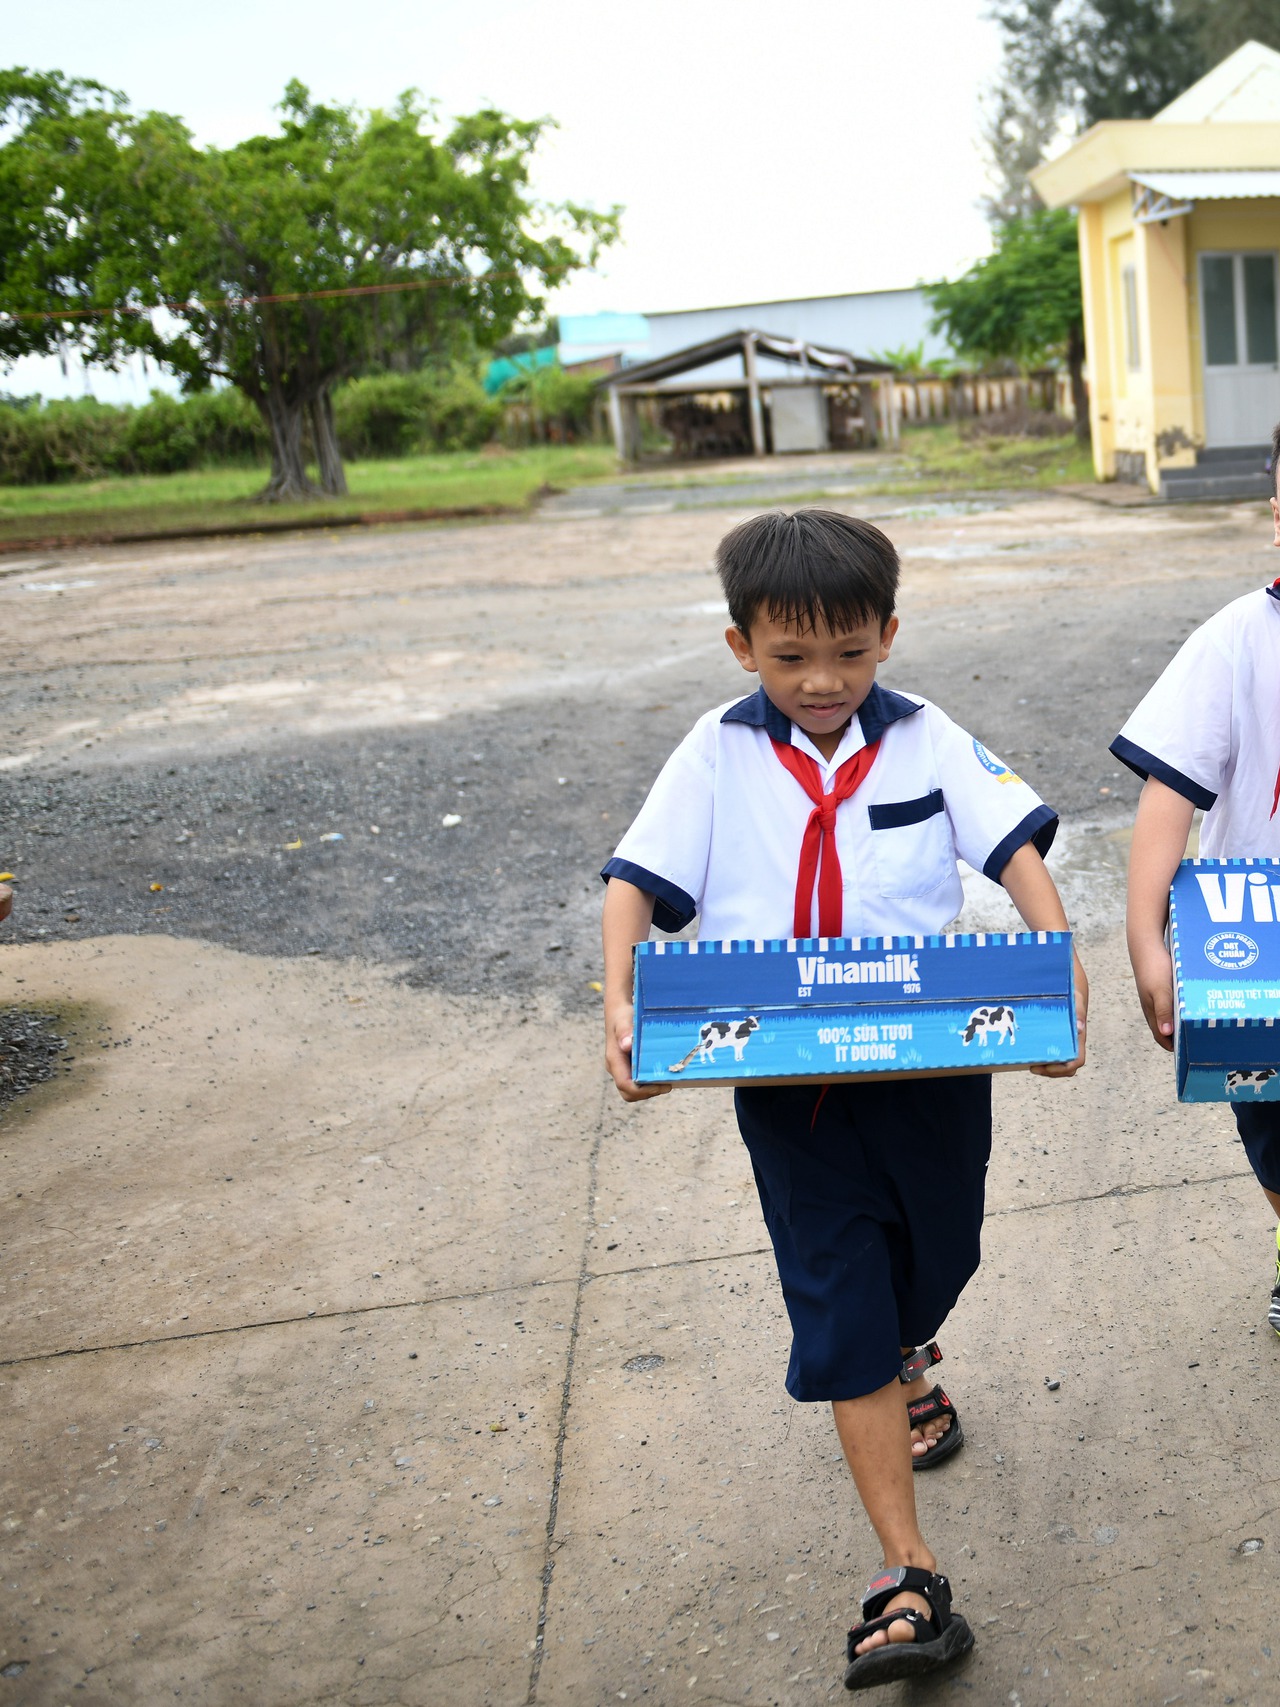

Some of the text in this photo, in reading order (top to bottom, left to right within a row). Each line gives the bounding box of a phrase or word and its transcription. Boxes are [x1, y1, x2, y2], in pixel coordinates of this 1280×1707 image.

[798, 983, 921, 997] EST 1976
[817, 1027, 851, 1044] 100%
[835, 1043, 848, 1063] ÍT
[909, 1402, 935, 1417] Fashion
